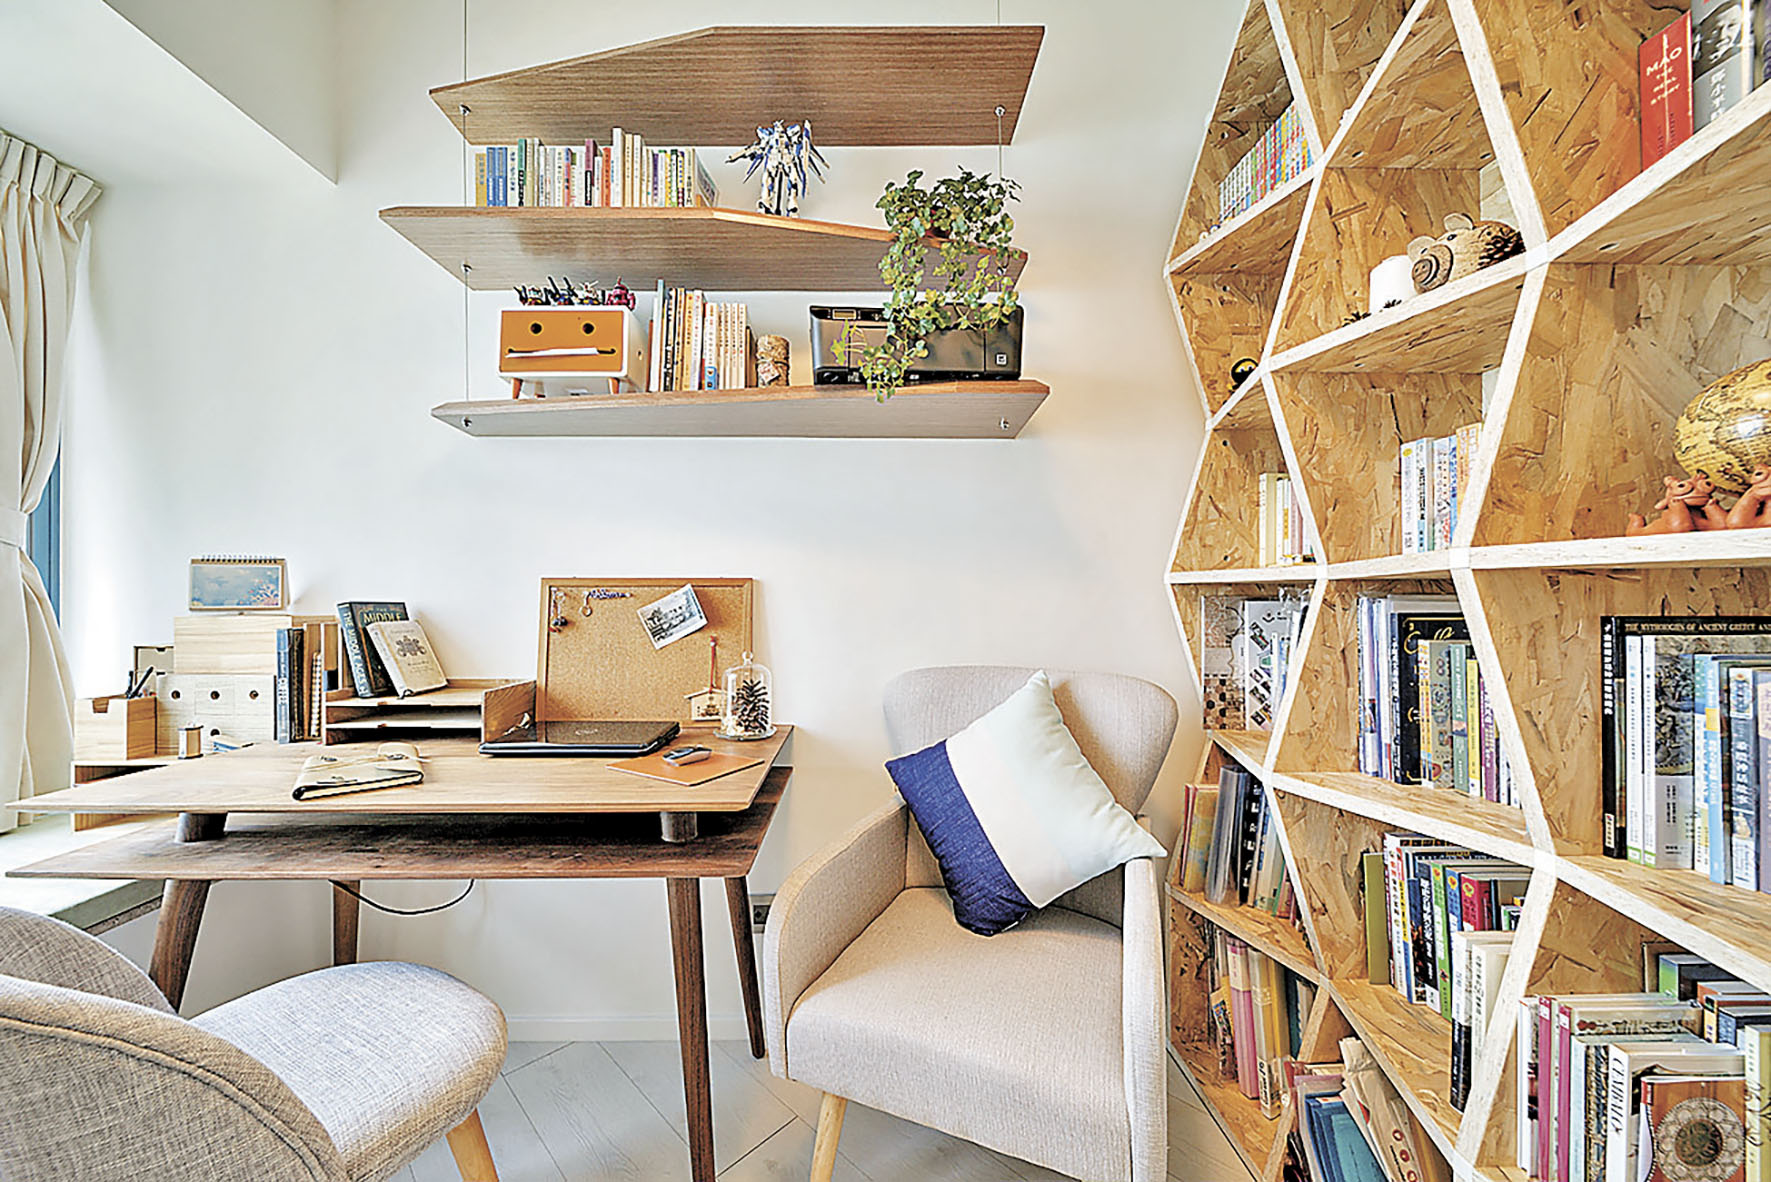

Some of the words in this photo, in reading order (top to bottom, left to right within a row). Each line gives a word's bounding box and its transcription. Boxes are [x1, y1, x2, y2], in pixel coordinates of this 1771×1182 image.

[1646, 46, 1682, 76] MAO
[342, 611, 354, 628] THE
[363, 612, 401, 623] MIDDLE
[1698, 623, 1728, 632] ANCIENT
[347, 628, 362, 660] MIDDLE
[354, 661, 369, 685] AGES
